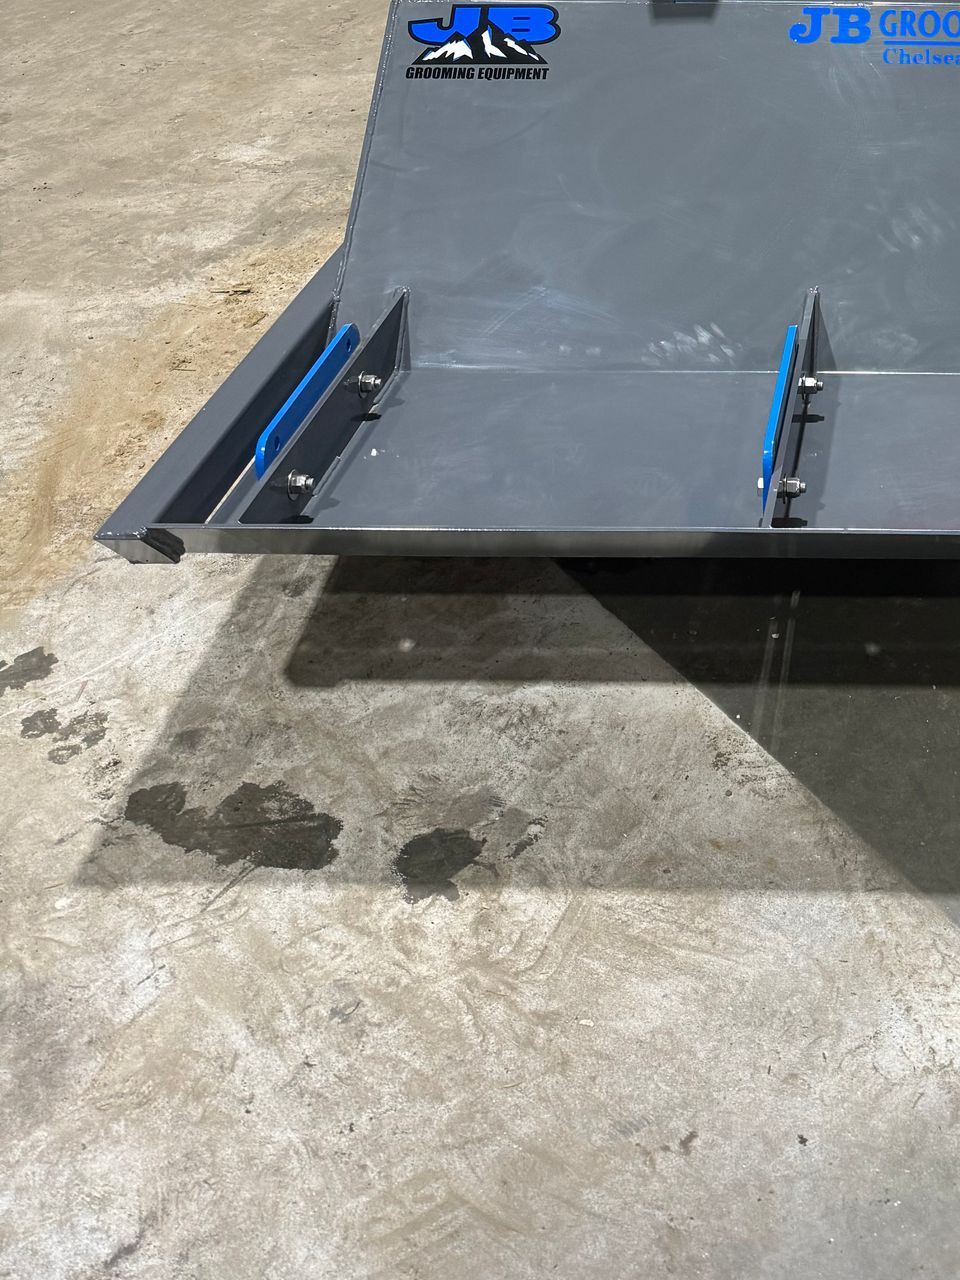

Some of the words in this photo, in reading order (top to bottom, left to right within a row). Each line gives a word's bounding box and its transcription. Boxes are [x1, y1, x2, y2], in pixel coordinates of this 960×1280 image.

[408, 4, 561, 46] JB
[788, 6, 872, 45] JB
[405, 66, 475, 80] GROOMING
[477, 67, 549, 80] EQUIPMENT
